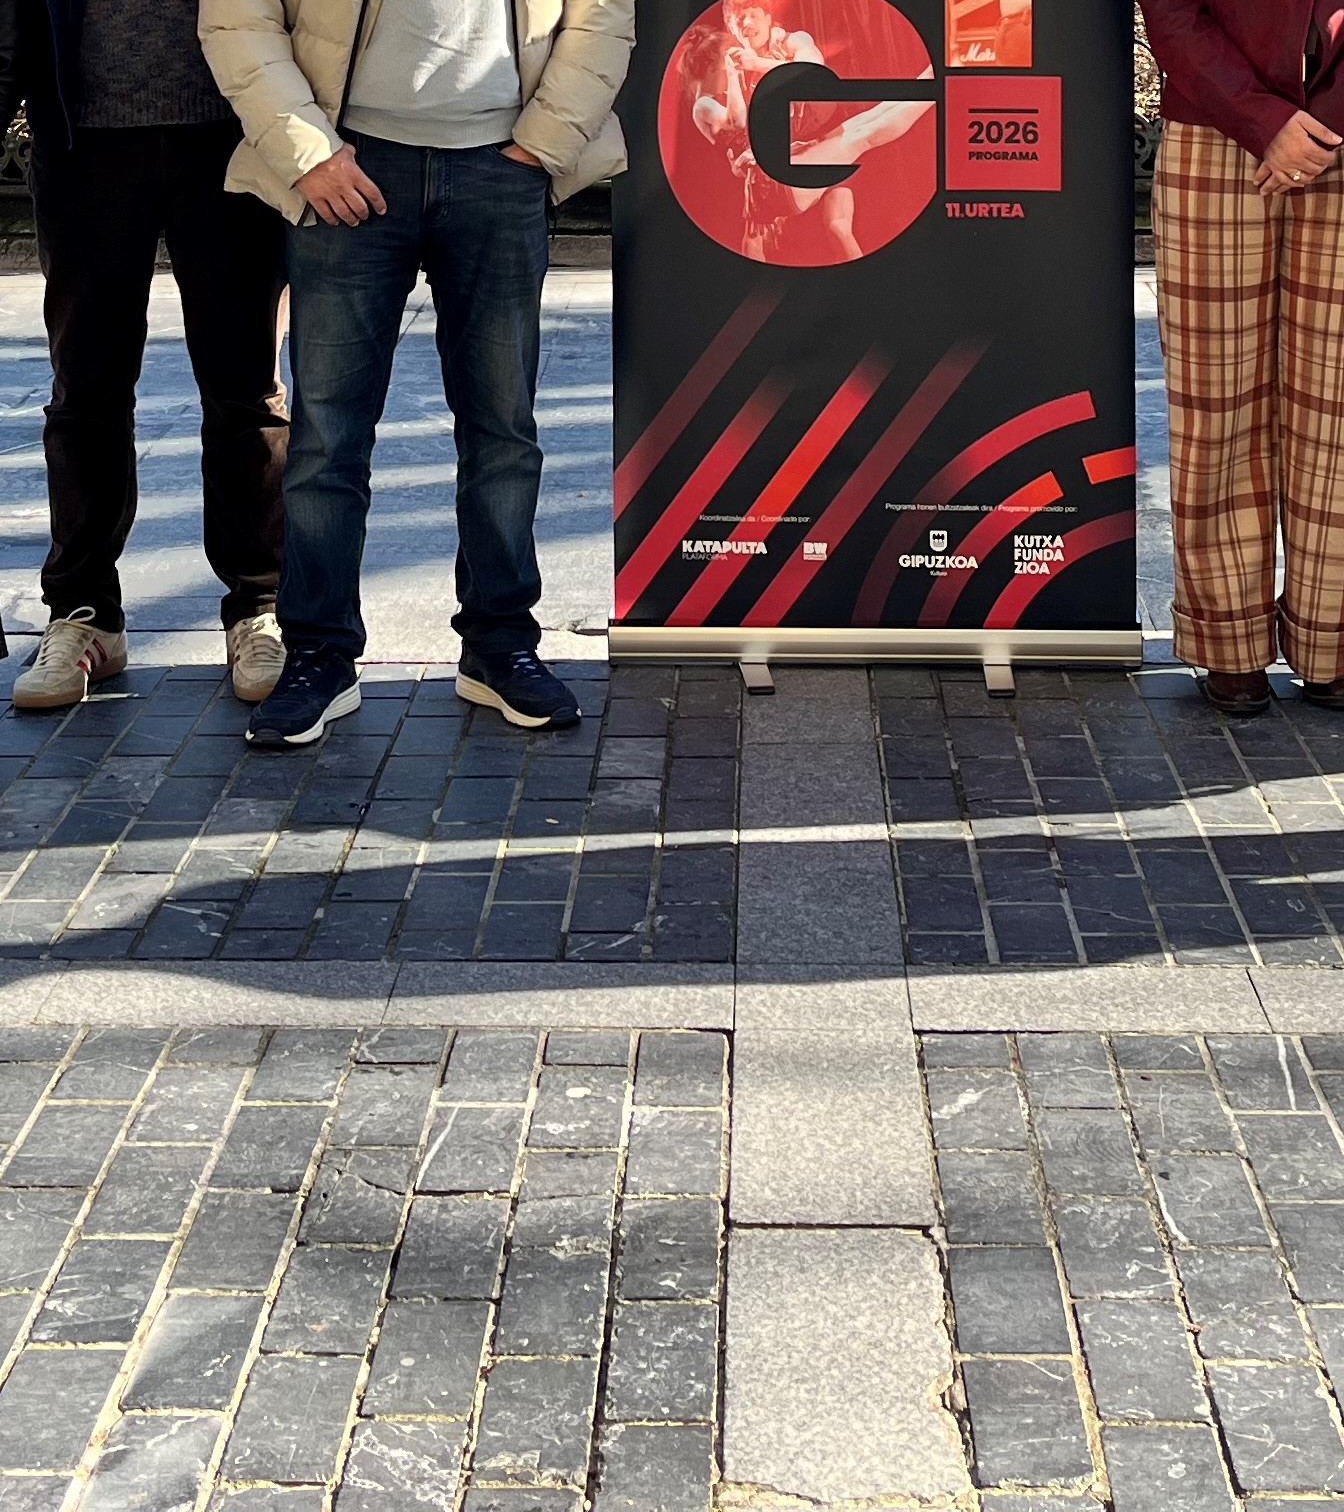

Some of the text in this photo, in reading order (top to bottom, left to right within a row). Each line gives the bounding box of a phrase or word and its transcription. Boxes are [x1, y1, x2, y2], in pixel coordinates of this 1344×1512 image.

[967, 120, 1039, 144] 2026
[967, 150, 1039, 162] PROGRAMA
[682, 540, 827, 554] KATAPULTA BW
[1014, 534, 1065, 548] KUTXA
[898, 555, 978, 568] GIPUZKOA
[1014, 548, 1065, 562] FUNDA
[1014, 561, 1051, 575] ZIOA
